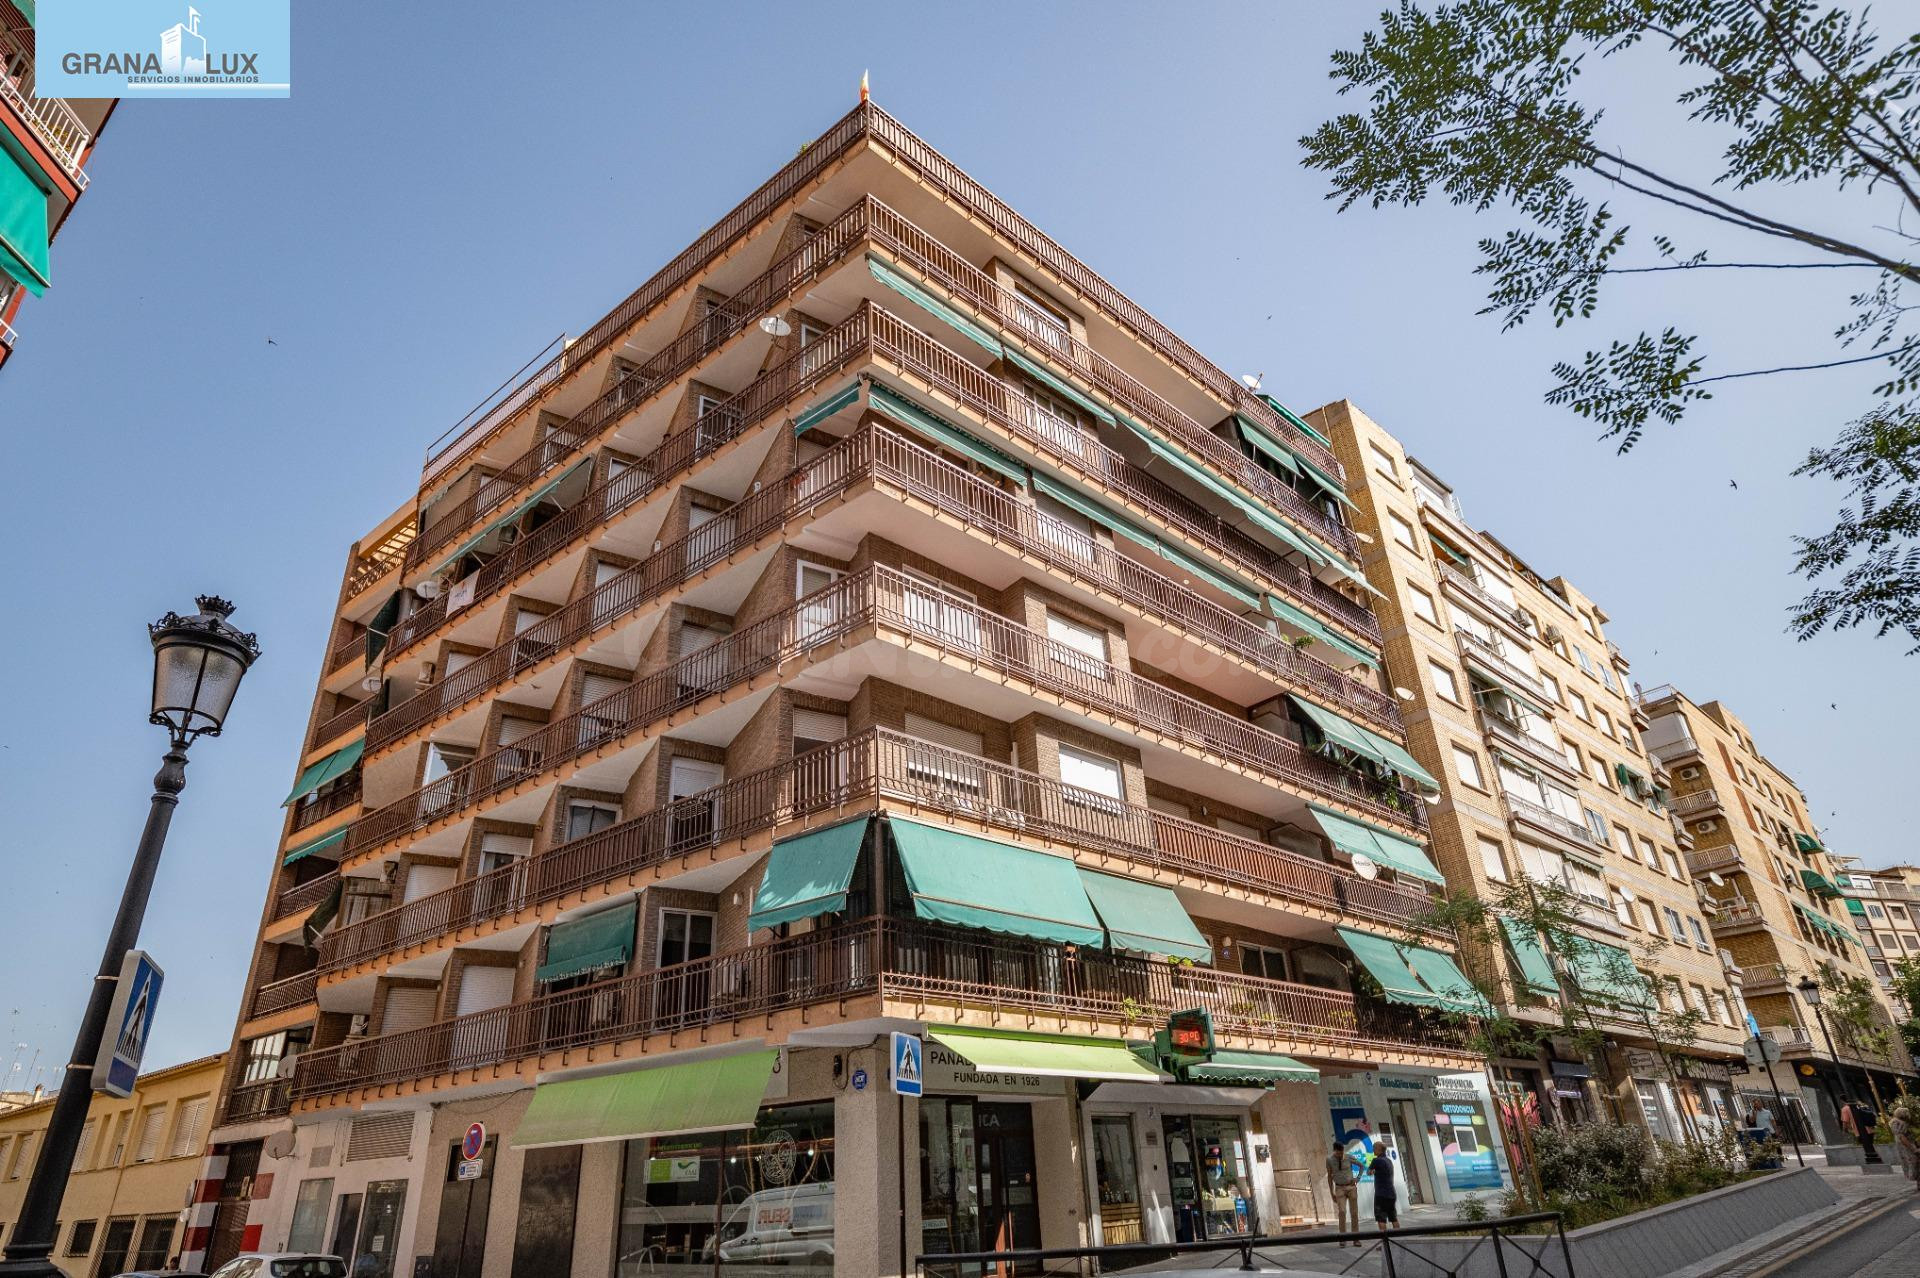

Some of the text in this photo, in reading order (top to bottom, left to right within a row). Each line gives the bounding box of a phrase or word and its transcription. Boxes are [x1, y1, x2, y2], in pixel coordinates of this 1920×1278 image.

[954, 1072, 1040, 1087] FUNDADA EN 1926
